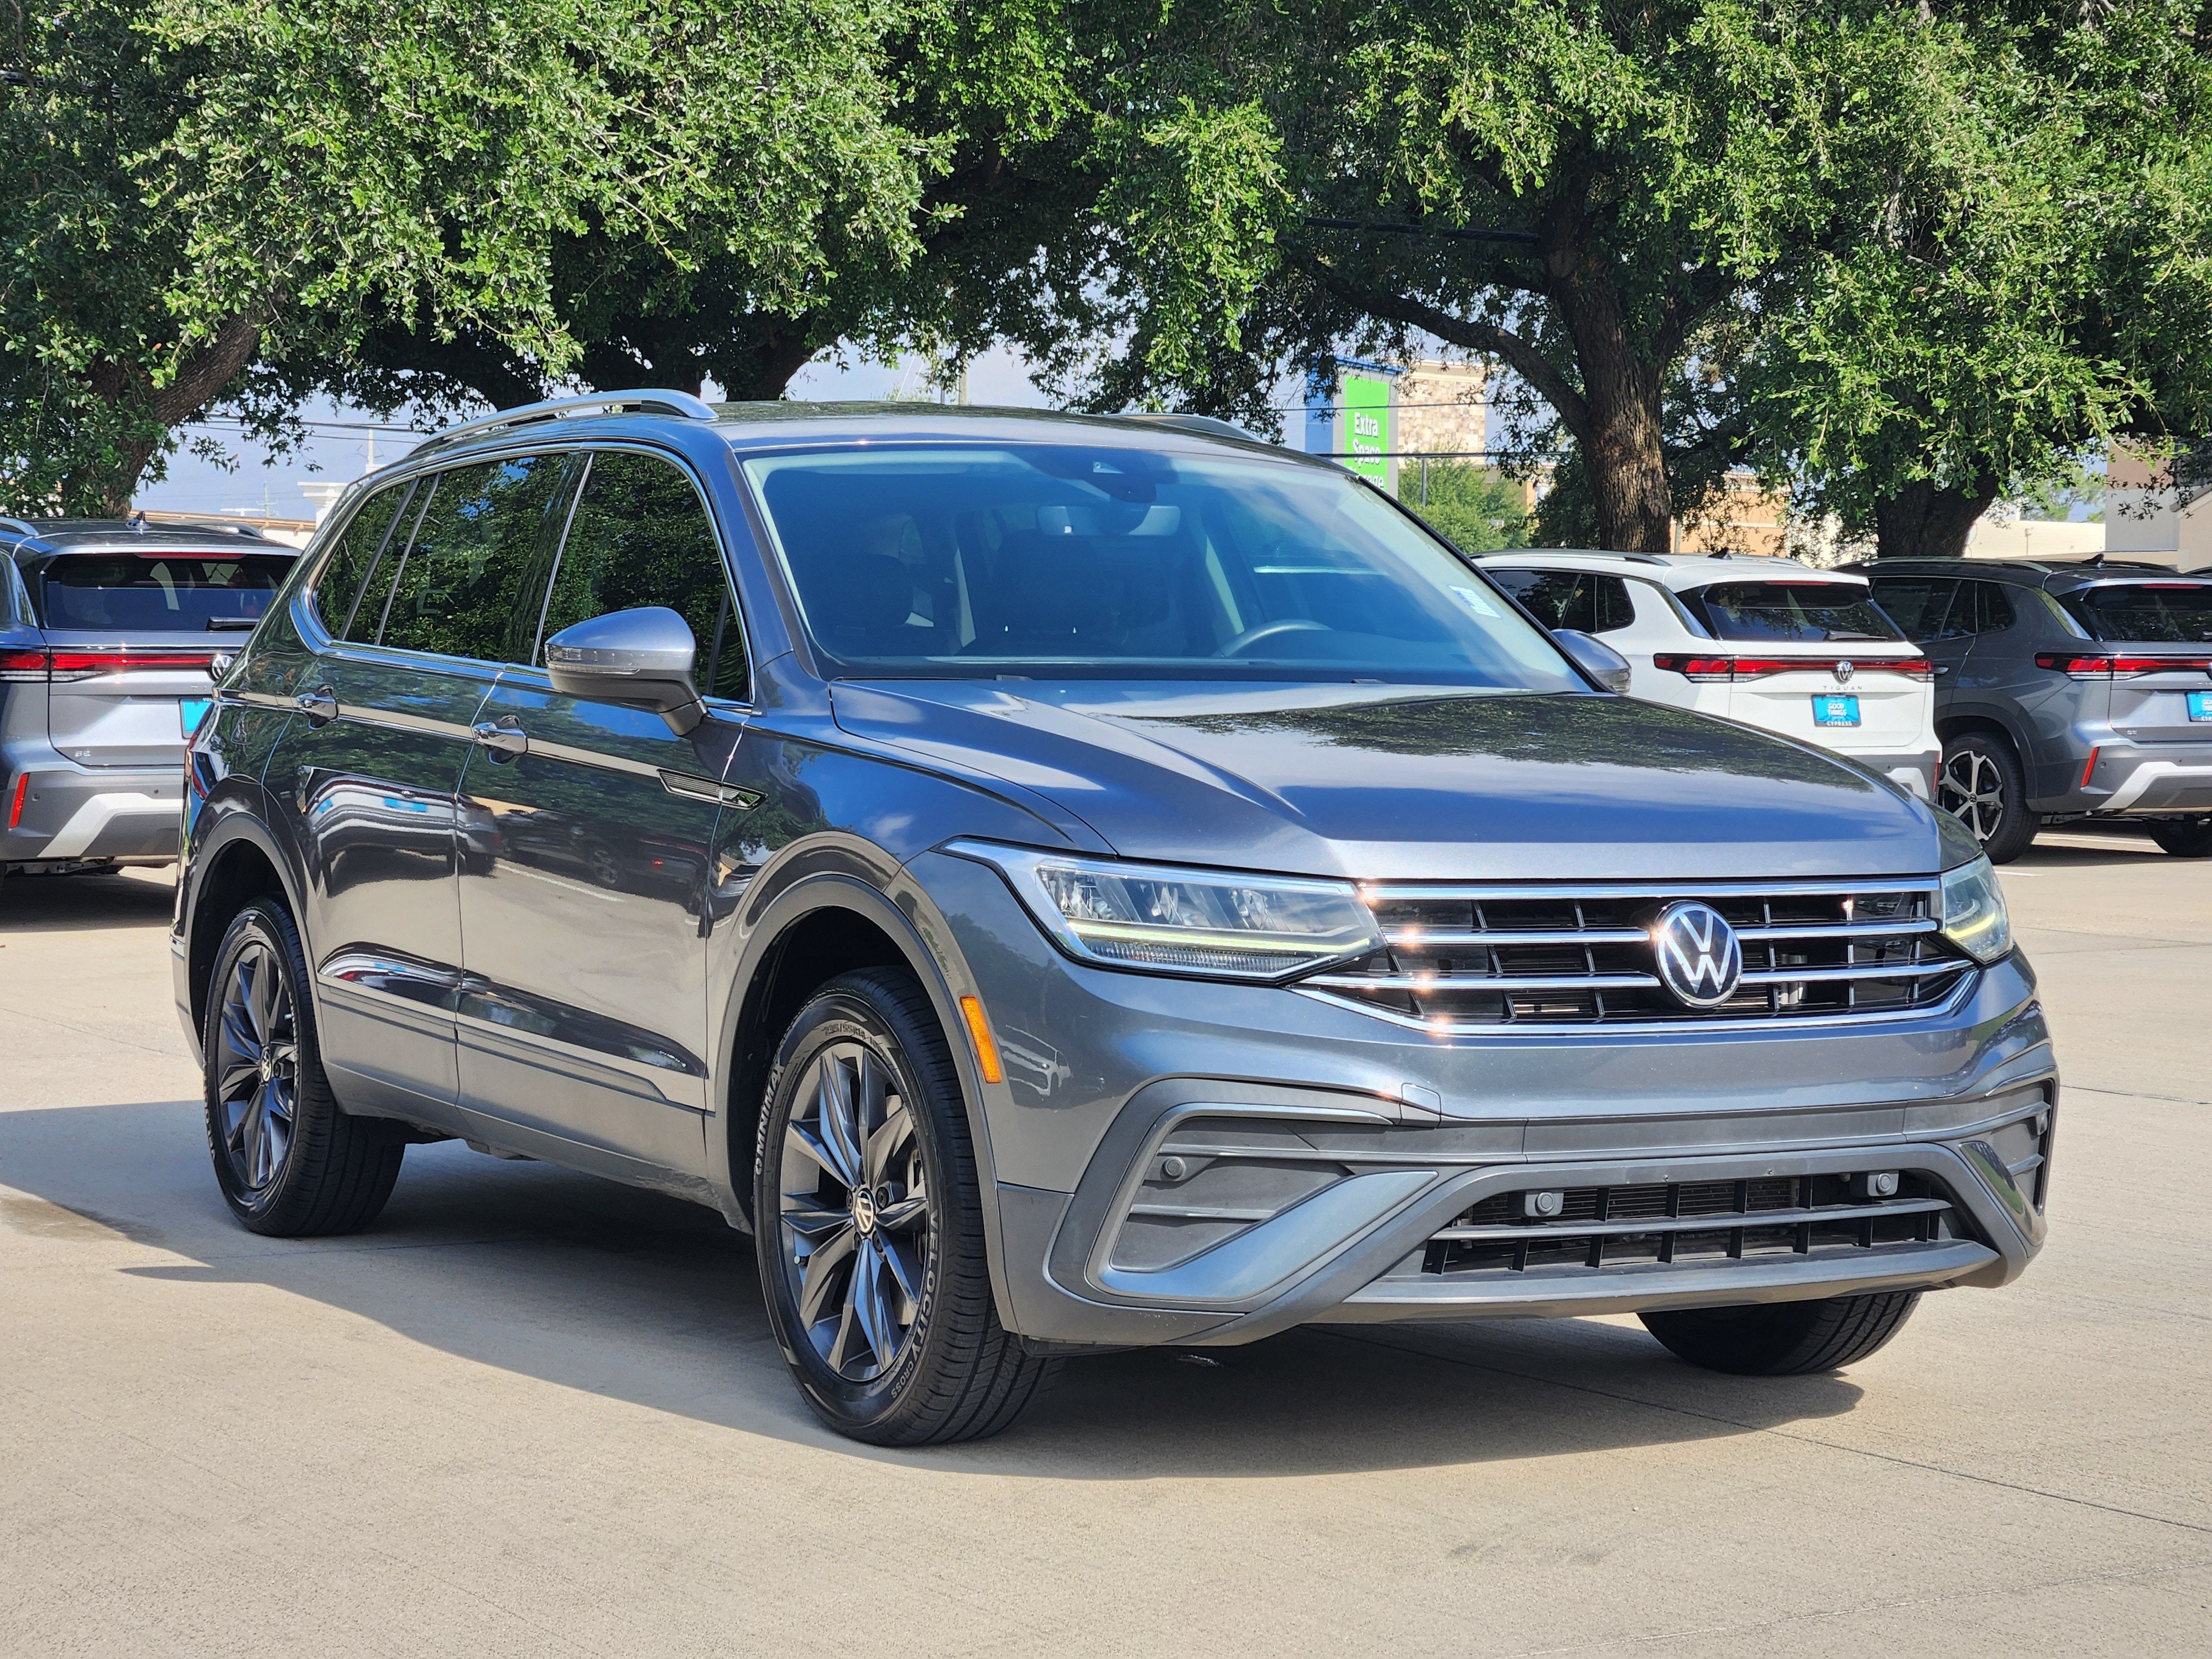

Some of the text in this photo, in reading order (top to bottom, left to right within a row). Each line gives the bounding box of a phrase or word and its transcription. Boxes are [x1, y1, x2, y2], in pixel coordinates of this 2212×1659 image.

[1353, 437, 1381, 468] Space
[1354, 411, 1379, 438] Extra
[1657, 904, 1741, 1005] VW
[755, 1057, 785, 1175] OMNIMAX
[891, 1209, 938, 1399] VELOCITY CROSS
